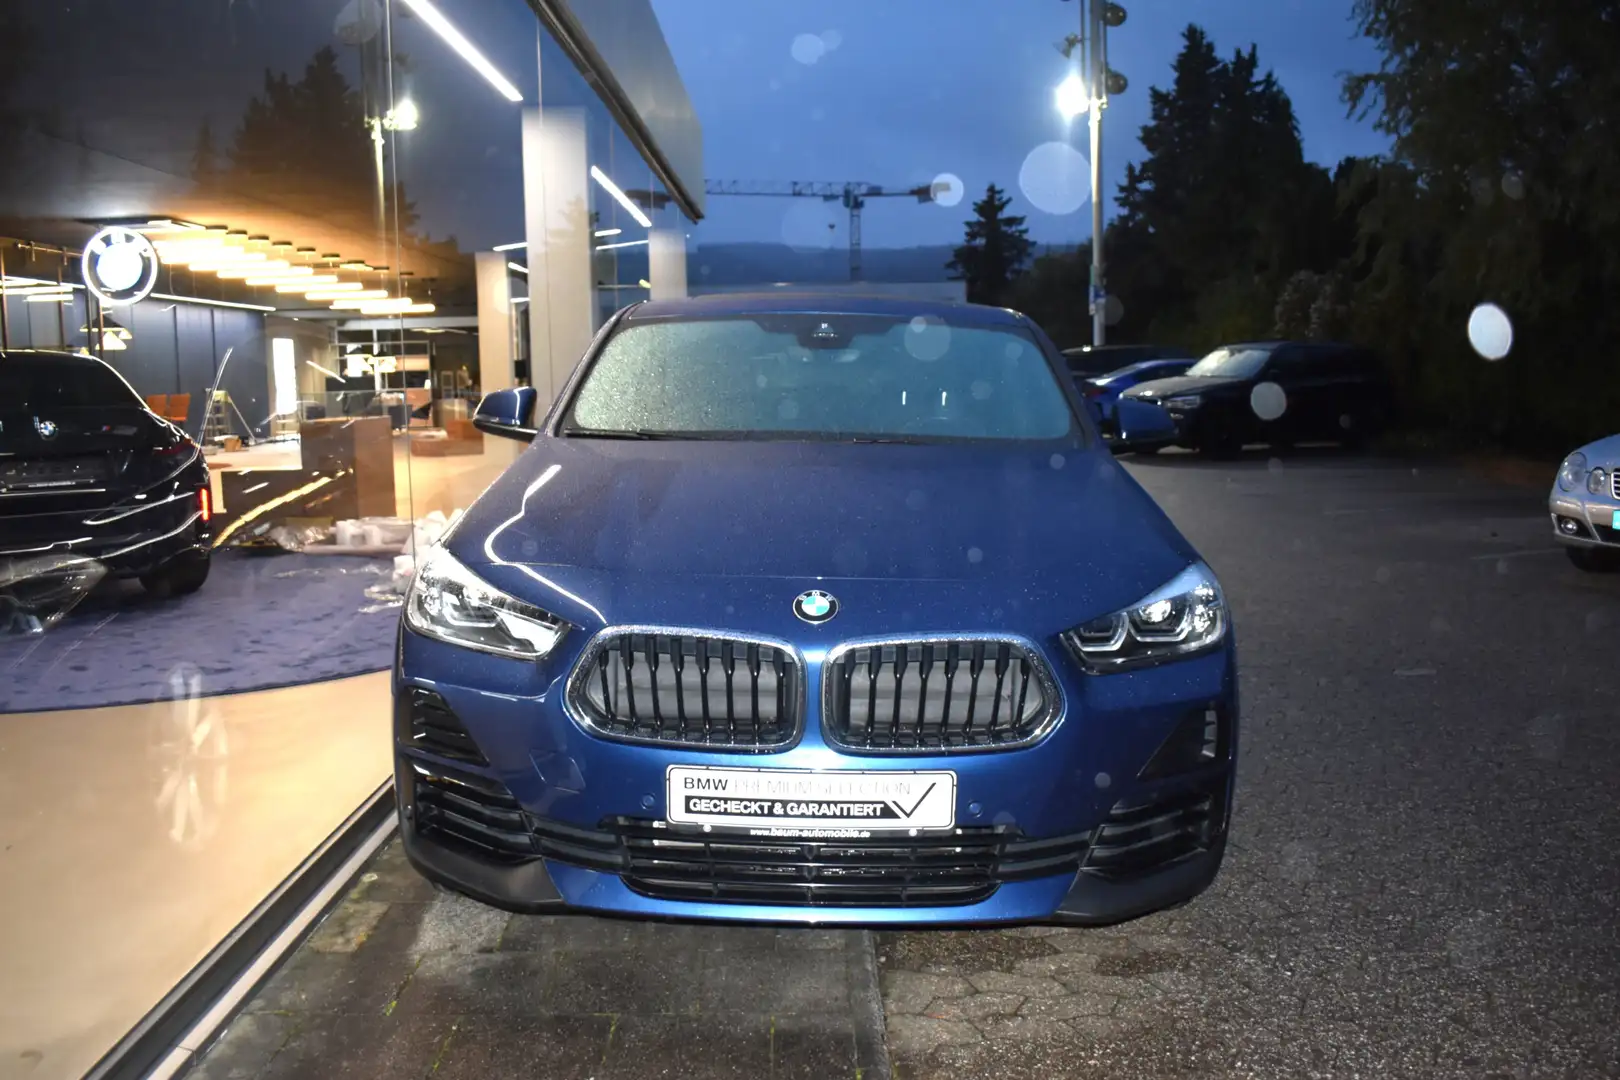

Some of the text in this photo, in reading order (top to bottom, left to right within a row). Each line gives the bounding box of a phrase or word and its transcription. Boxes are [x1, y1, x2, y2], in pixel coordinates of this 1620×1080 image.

[684, 777, 728, 790] BMW
[689, 798, 884, 816] GECHECKT & GARANTIERT
[750, 827, 871, 838] www.baum-automobile.de
